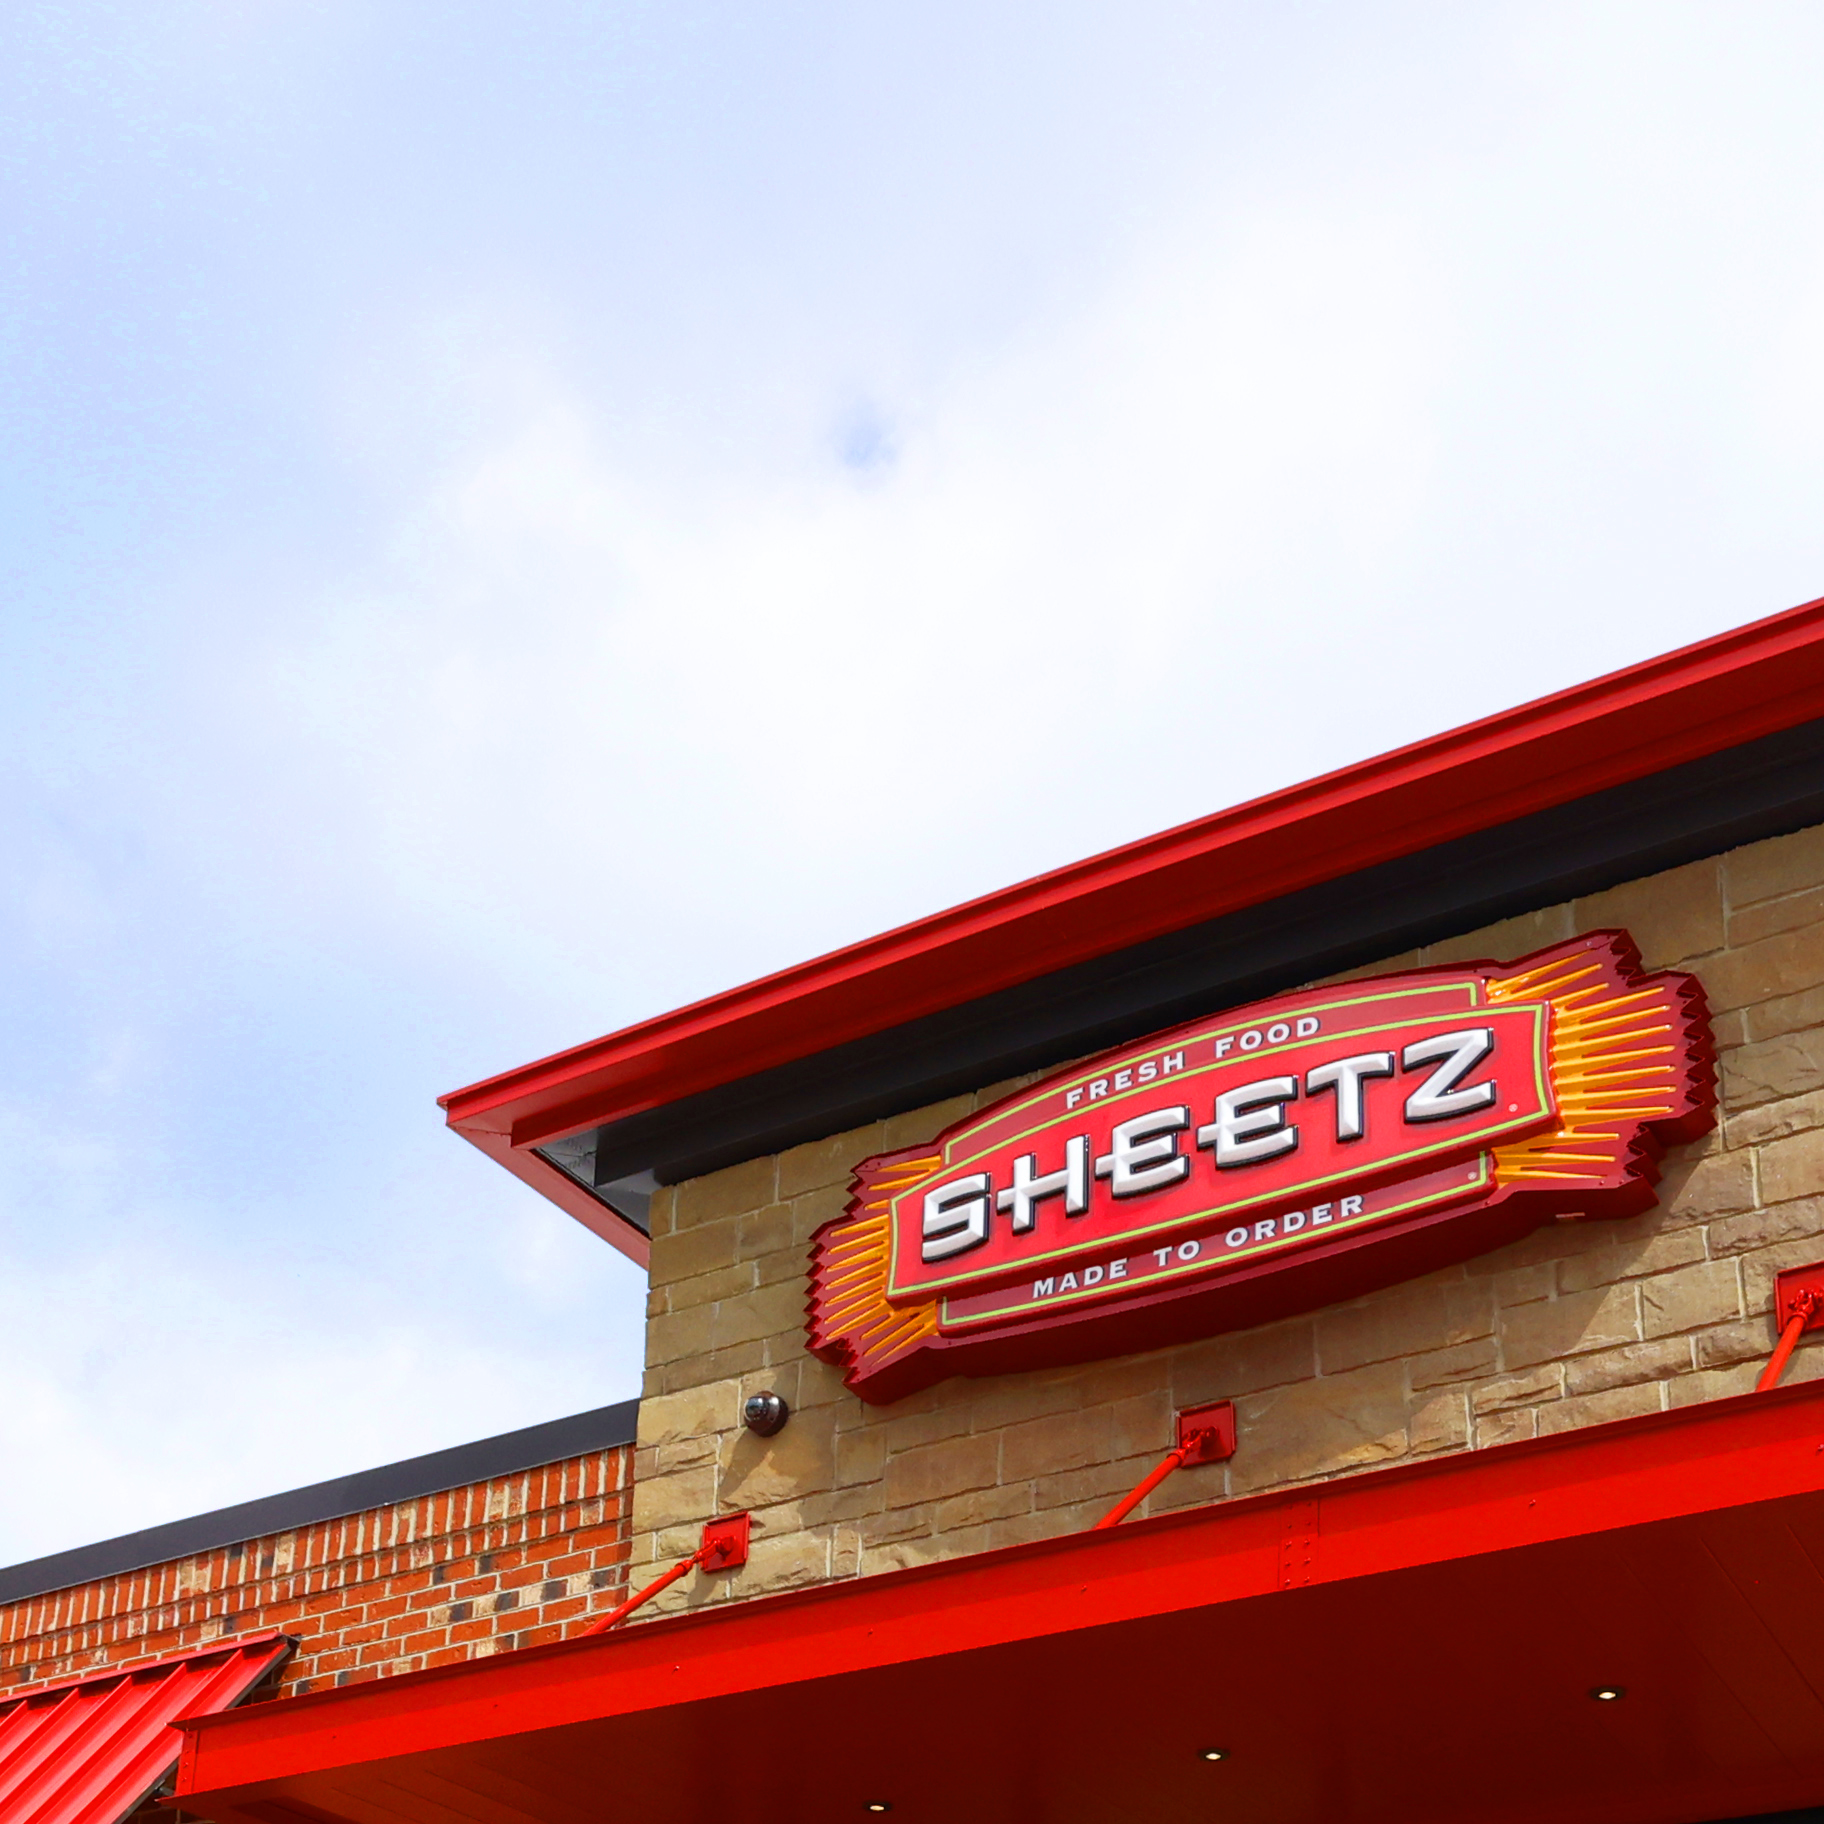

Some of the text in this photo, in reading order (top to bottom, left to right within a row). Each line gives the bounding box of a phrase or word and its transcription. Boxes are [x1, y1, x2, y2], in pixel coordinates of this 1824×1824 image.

[1066, 1016, 1321, 1110] FRESH FOOD
[921, 1026, 1496, 1264] SHEETZ
[1032, 1195, 1364, 1300] MADE TO ORDER
